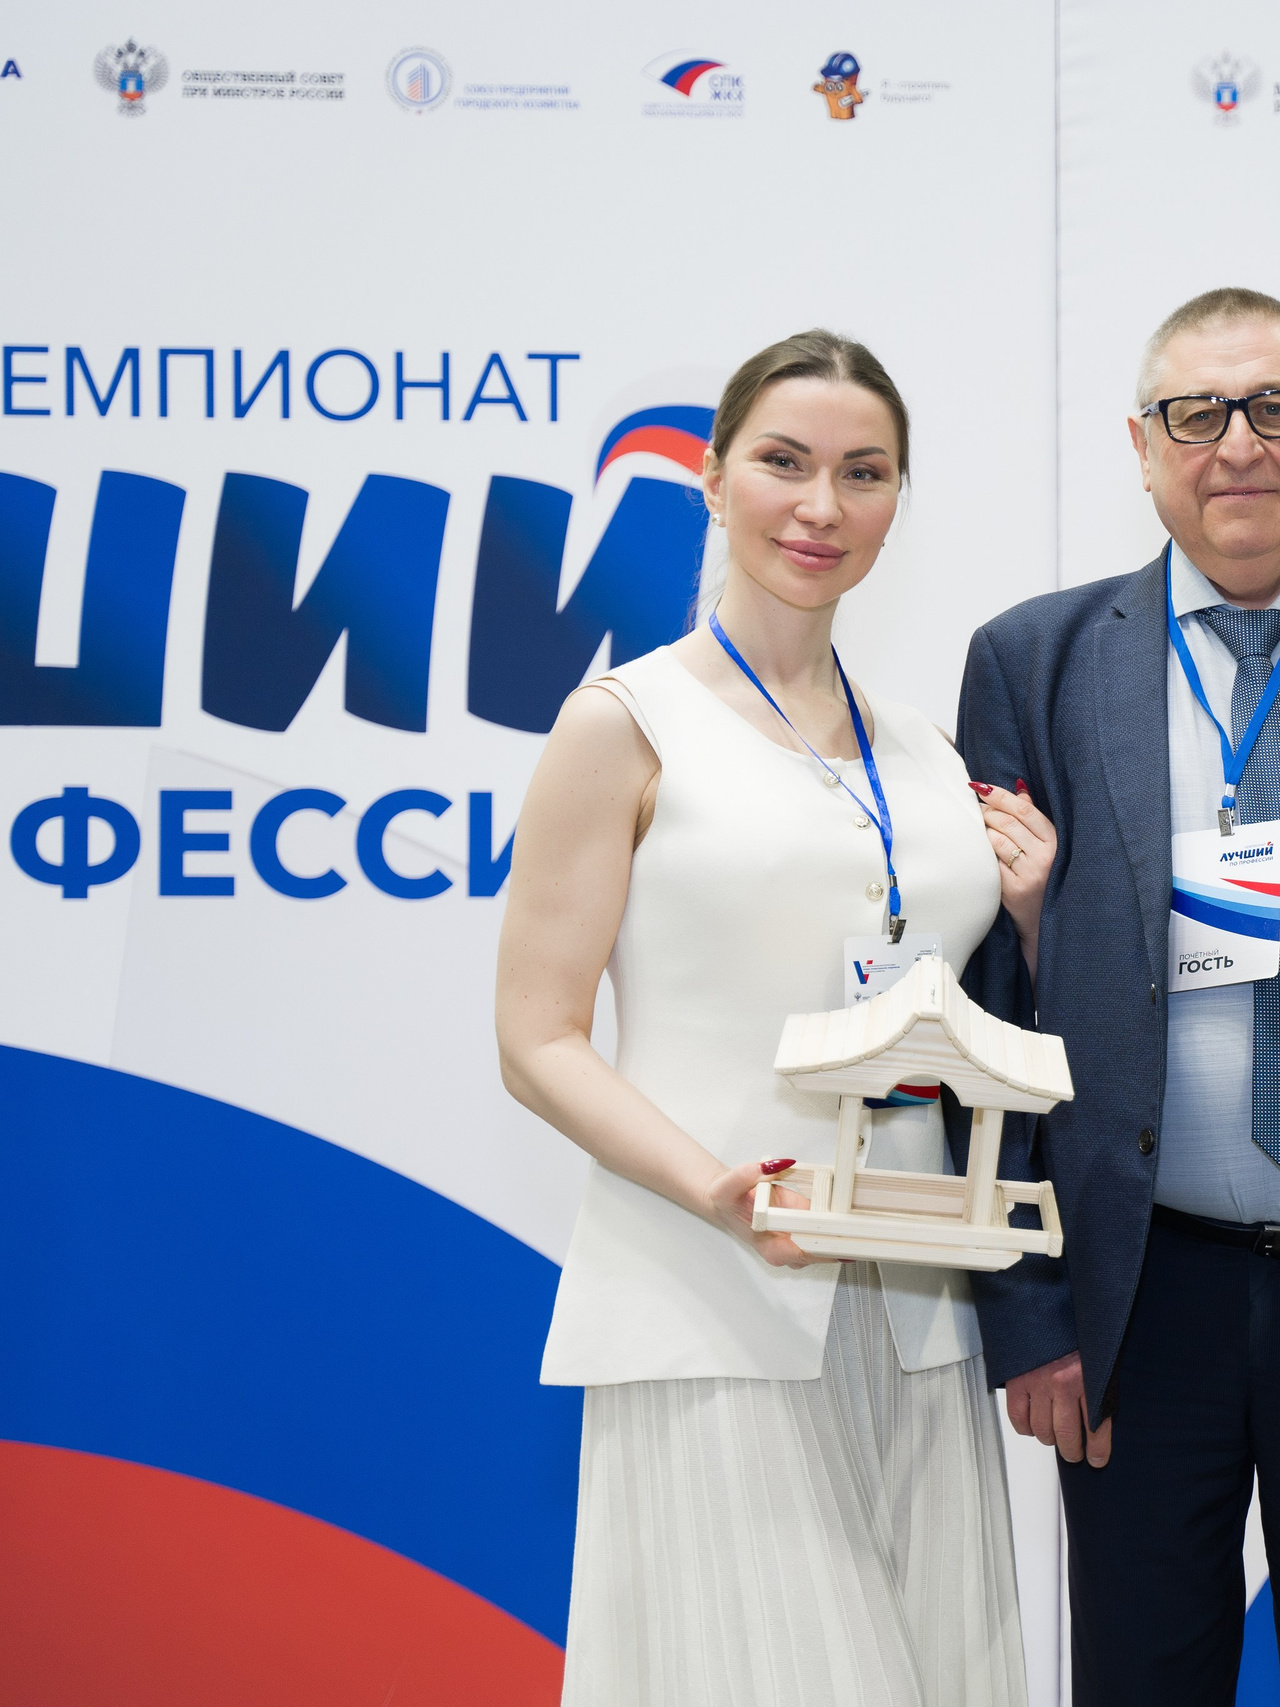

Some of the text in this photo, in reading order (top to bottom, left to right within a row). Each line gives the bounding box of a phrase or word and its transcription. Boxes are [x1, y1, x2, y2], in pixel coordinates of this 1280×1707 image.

[1, 60, 22, 79] А
[289, 87, 345, 100] РОССИИ
[2, 344, 581, 423] ЕМПИОНАТ
[1220, 842, 1274, 862] ЛУЧШИЙ
[1239, 856, 1274, 865] ПРОФЕССИИ
[1179, 955, 1234, 975] ГОСТЬ
